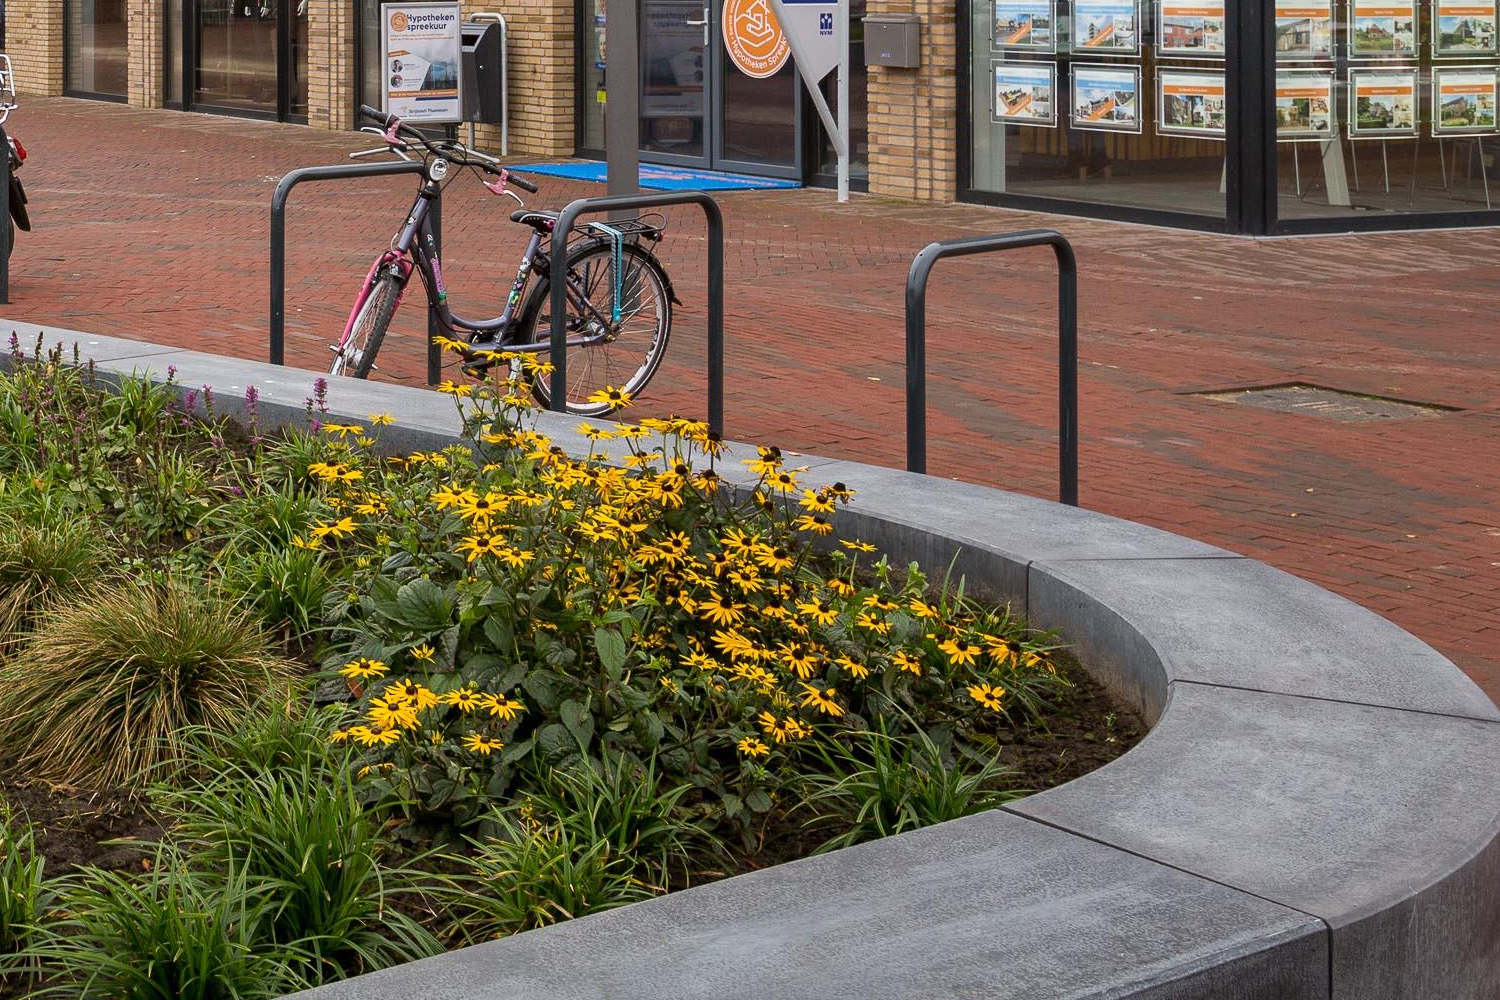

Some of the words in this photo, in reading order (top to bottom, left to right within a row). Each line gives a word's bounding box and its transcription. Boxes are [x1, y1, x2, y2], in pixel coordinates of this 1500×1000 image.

[406, 13, 455, 24] Hypotheken
[406, 22, 447, 32] spreekuur
[731, 39, 768, 69] Hypotheken
